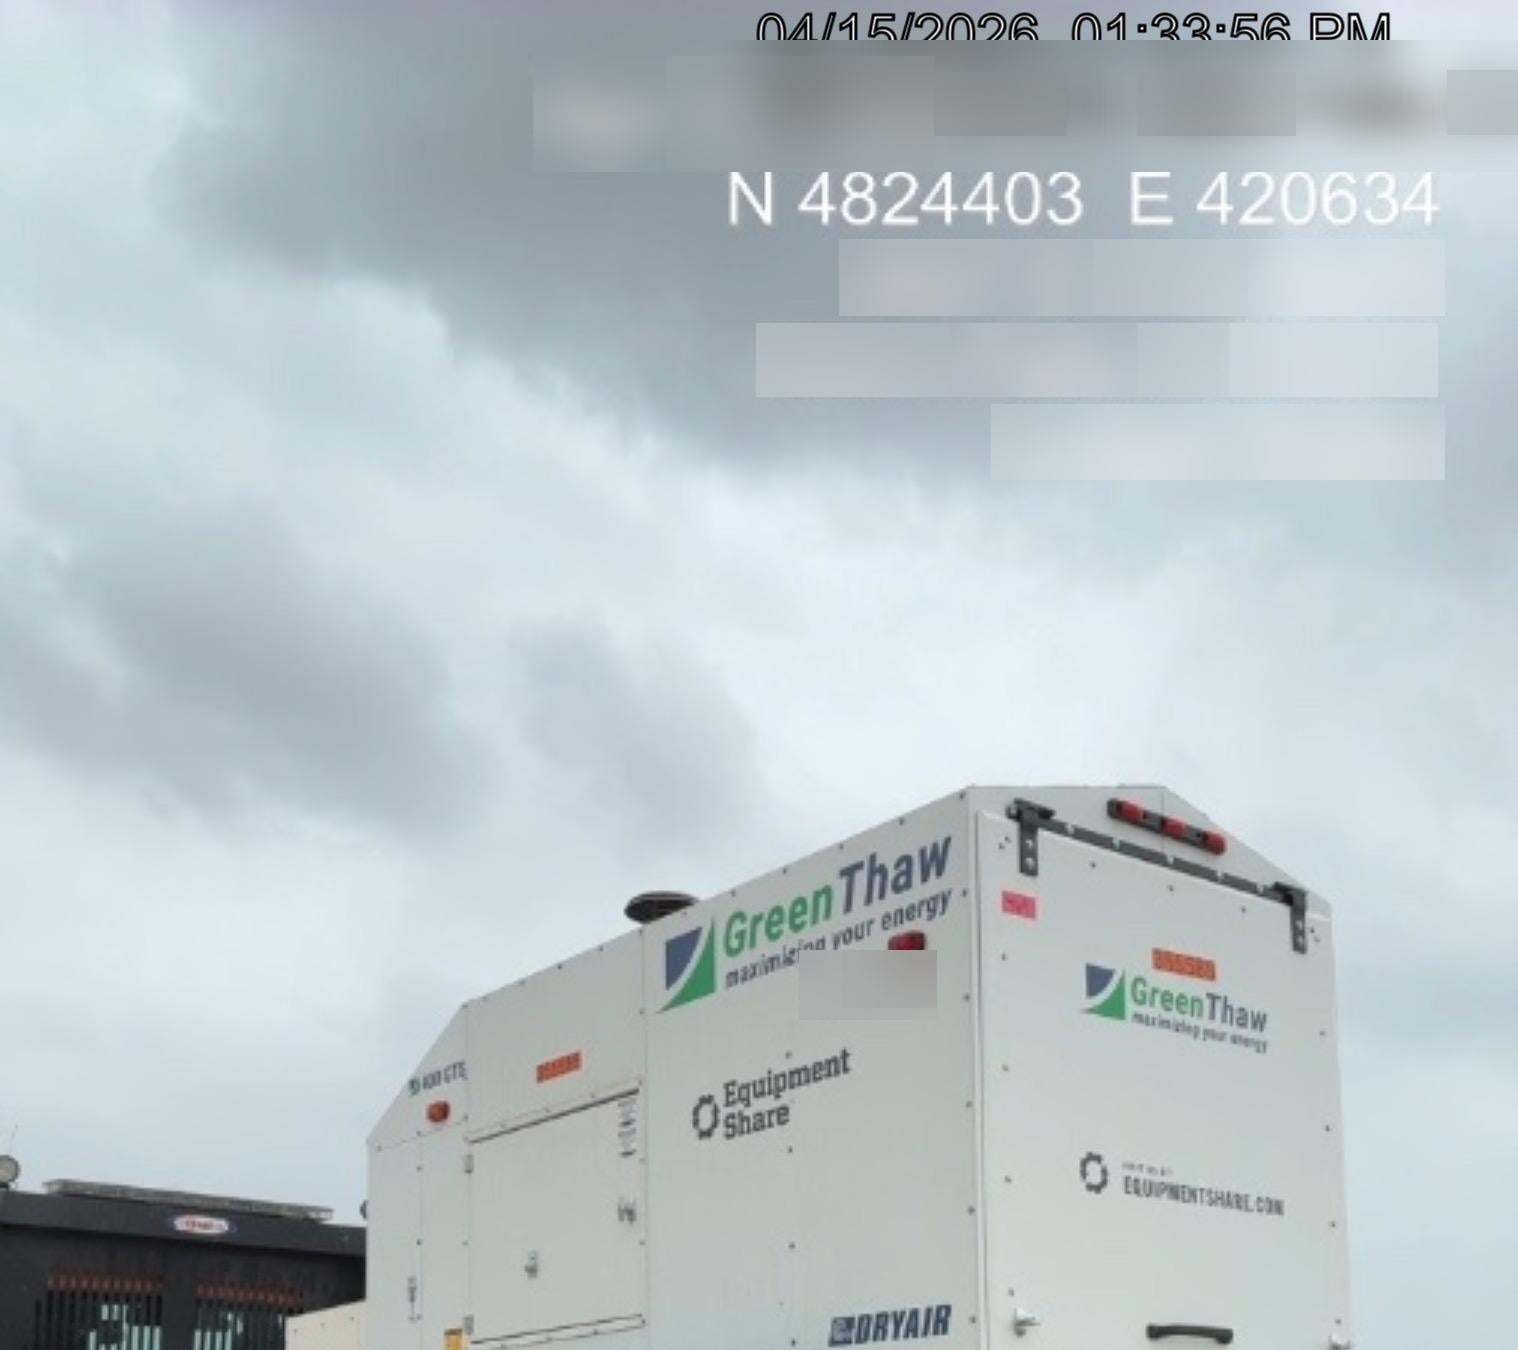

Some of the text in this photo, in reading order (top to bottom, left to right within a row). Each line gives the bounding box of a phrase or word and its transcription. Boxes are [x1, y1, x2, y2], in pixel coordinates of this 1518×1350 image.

[832, 918, 876, 950] your
[881, 888, 952, 922] energy
[722, 1048, 852, 1108] Equipment
[723, 1104, 790, 1140] Share
[1123, 1175, 1285, 1217] EQUIPMENTSHARE.COM
[854, 1304, 952, 1345] DRYAIR
